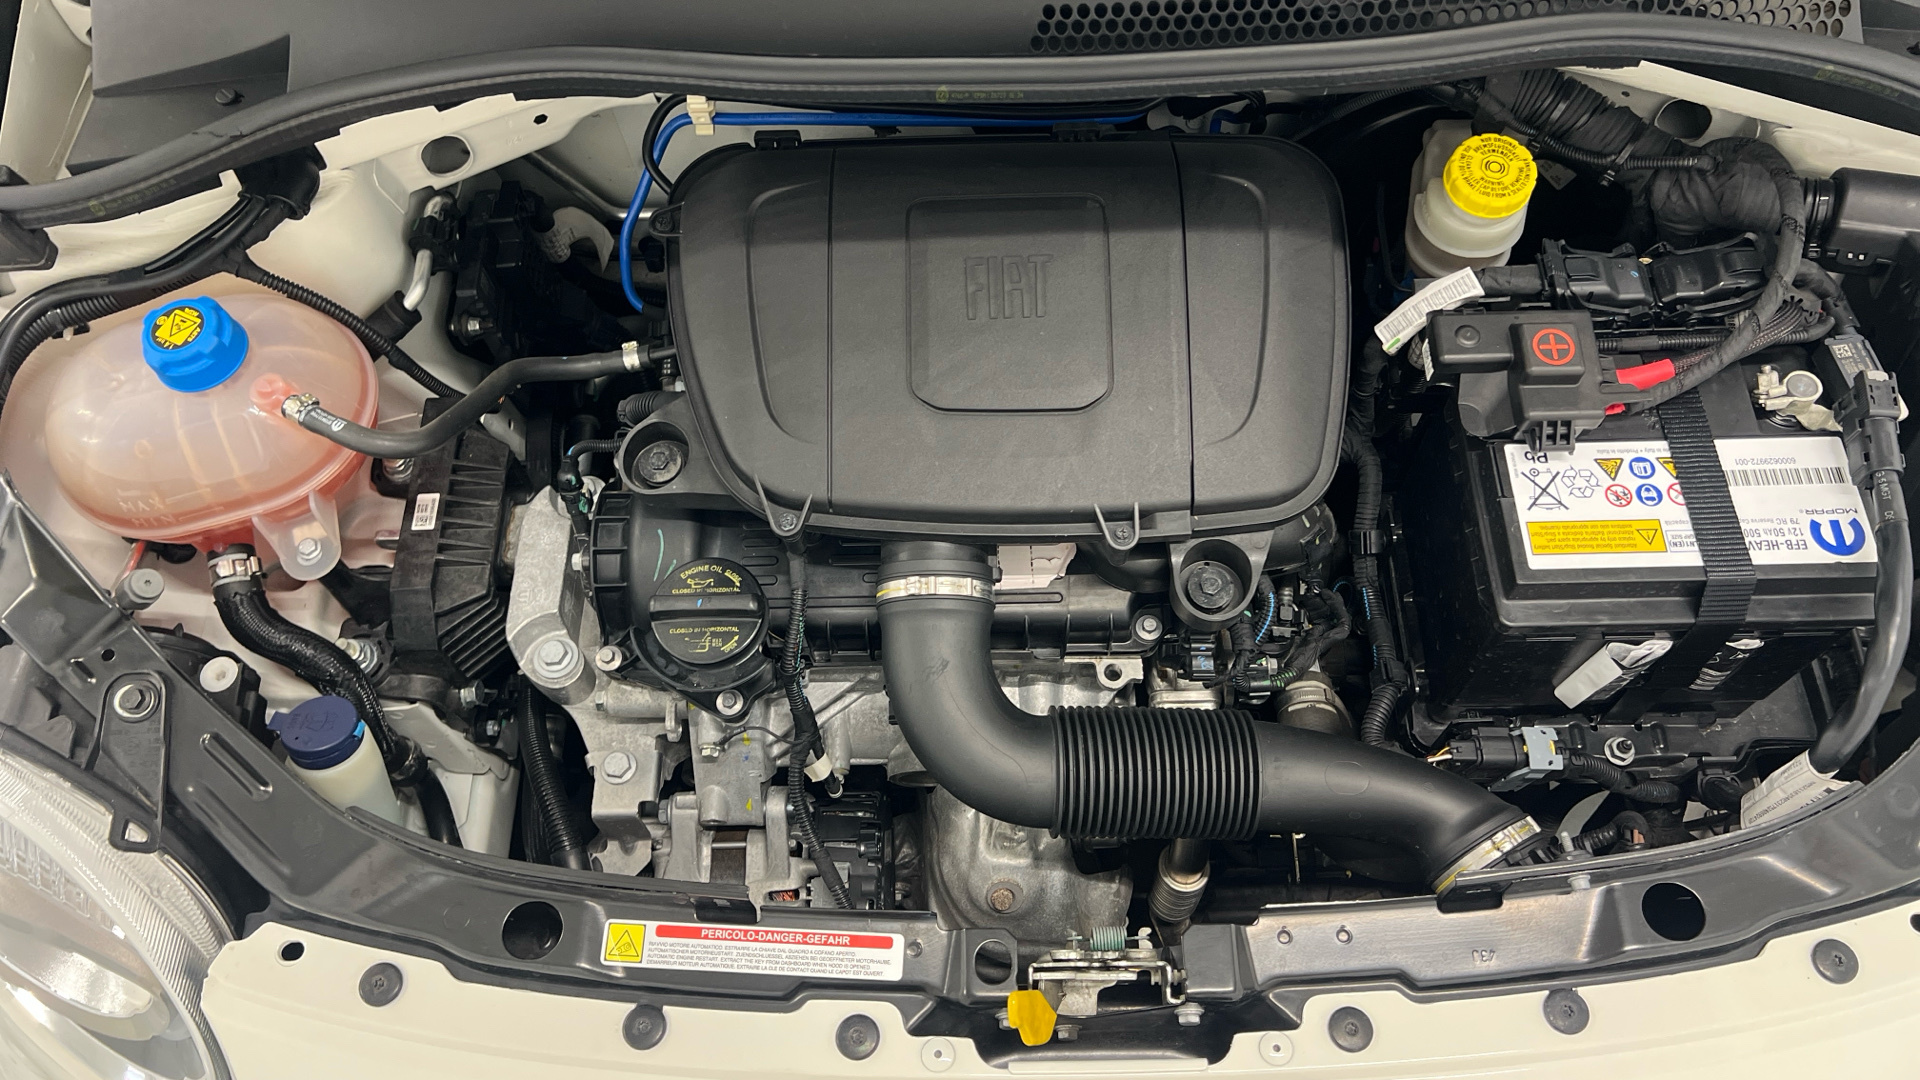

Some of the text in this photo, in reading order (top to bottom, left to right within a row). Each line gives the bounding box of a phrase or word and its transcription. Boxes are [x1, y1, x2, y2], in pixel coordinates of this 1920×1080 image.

[1494, 137, 1518, 150] ORIGINAL
[964, 253, 1053, 321] FIAT
[1524, 451, 1548, 464] Pb
[1743, 529, 1761, 538] 500
[1763, 528, 1785, 537] 50Ah
[680, 565, 723, 579] ENGINE OIL
[701, 928, 850, 945] PERICOLO-DANGER-GEFAHR
